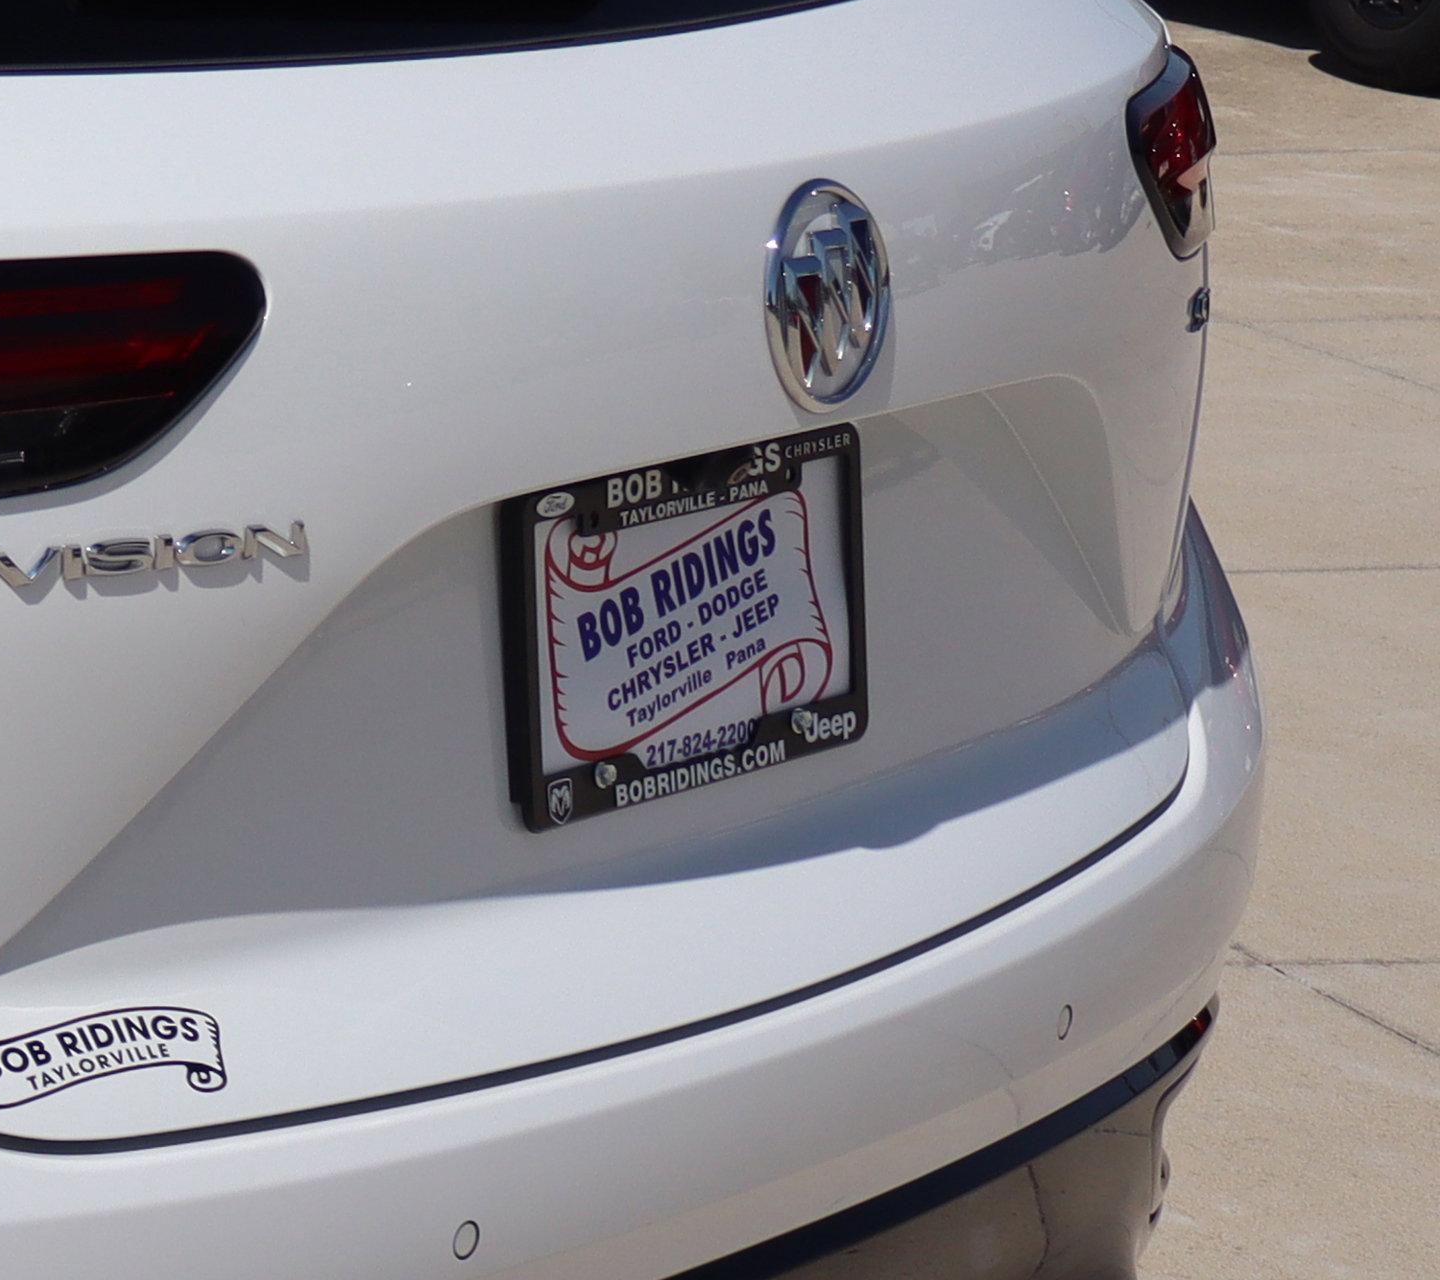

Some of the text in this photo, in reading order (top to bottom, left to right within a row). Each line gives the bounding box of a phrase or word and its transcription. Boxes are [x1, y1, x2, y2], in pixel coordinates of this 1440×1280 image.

[785, 432, 851, 460] CHRYSLER
[607, 469, 662, 509] BOB
[620, 490, 716, 527] TAYLORVILLE
[729, 480, 769, 503] PANA
[576, 508, 776, 663] BOB RIDINGS
[626, 620, 682, 669] FORD
[697, 568, 769, 626] DODGE
[607, 632, 717, 712] CHRYSLER
[732, 593, 780, 640] JEEP
[625, 637, 767, 728] Taylorville Pana
[646, 717, 757, 768] 217-824-2200
[806, 709, 857, 744] Jeep
[615, 738, 787, 808] BOBRIDINGS.COM
[55, 1015, 201, 1058] RIDINGS
[26, 1042, 171, 1091] TAYLORVILLE
